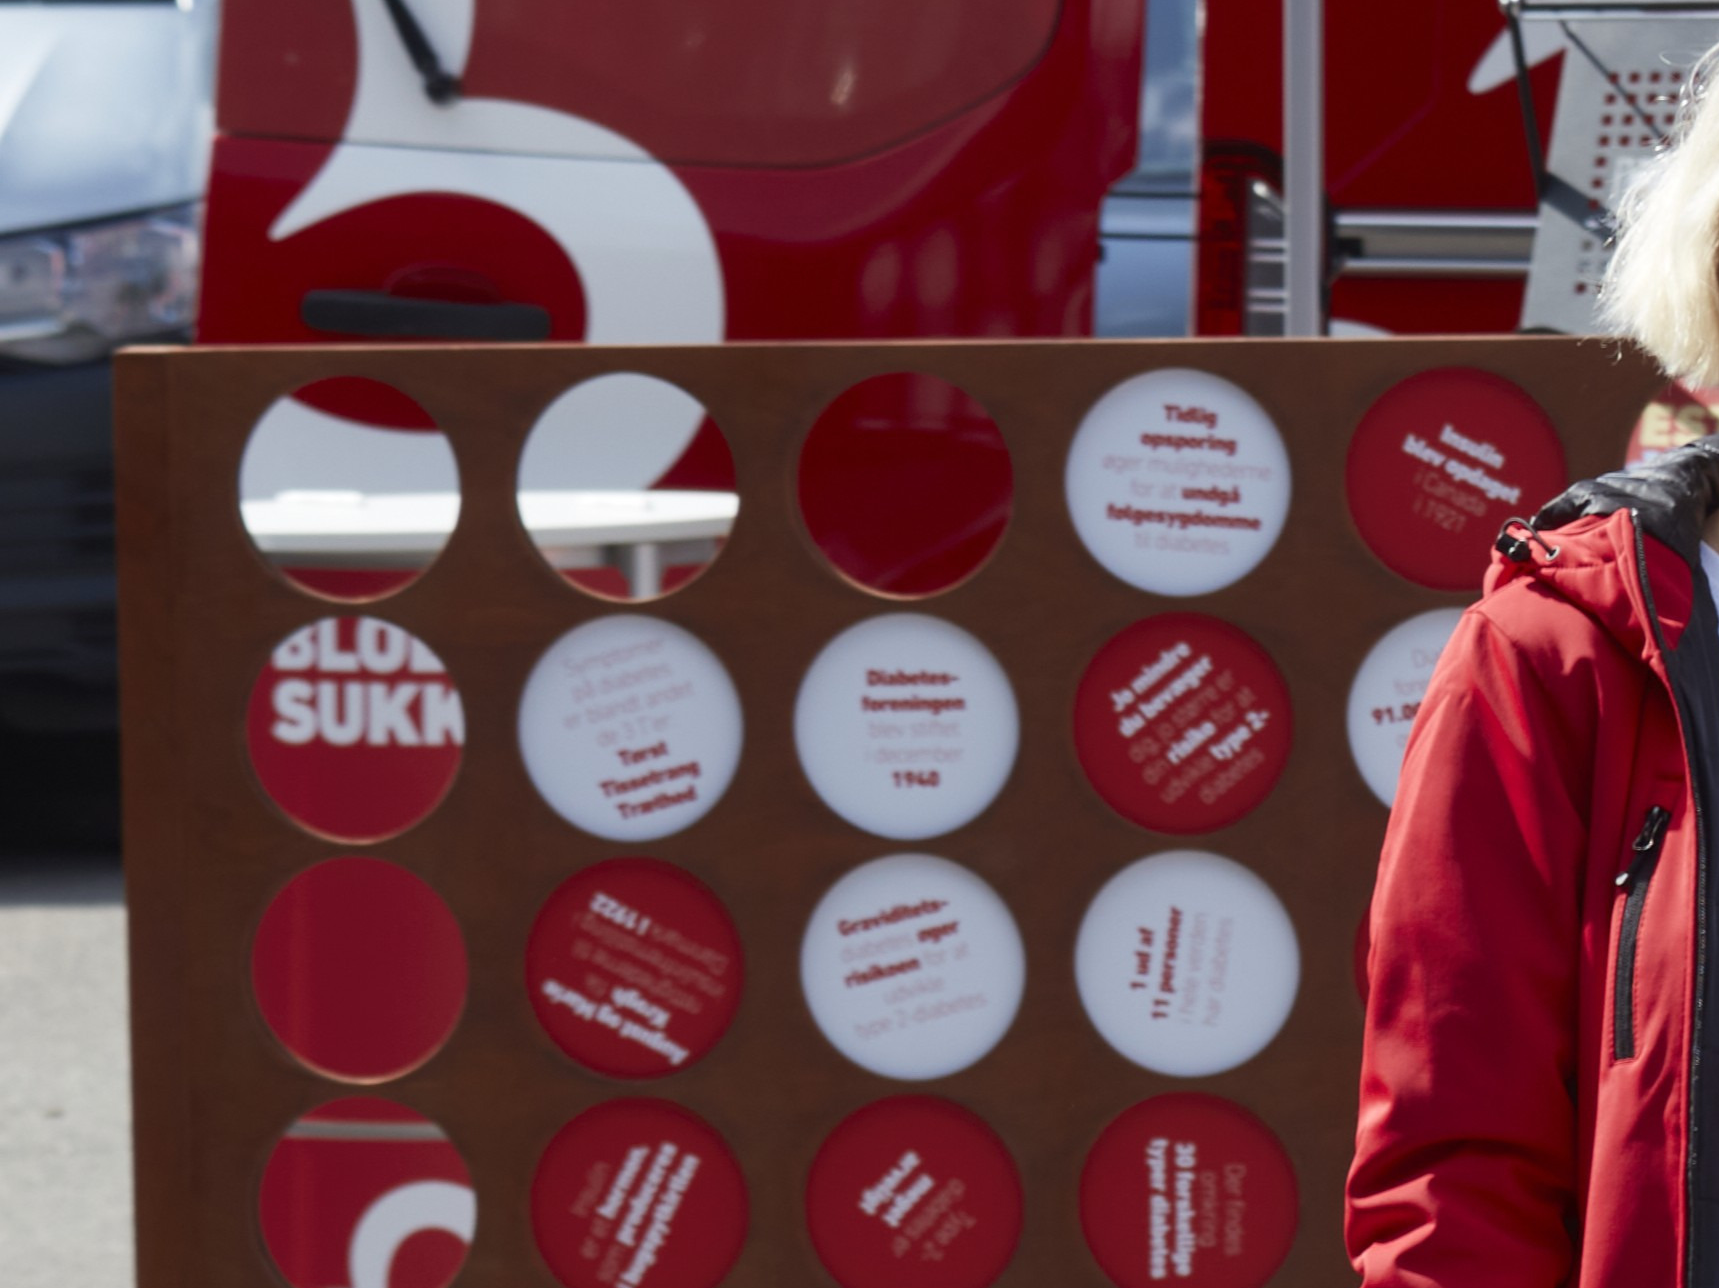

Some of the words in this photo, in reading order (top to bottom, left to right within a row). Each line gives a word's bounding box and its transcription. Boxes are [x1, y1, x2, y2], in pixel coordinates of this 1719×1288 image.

[270, 678, 465, 748] SUKK
[1159, 906, 1183, 995] personer
[1149, 1193, 1175, 1280] diabetes
